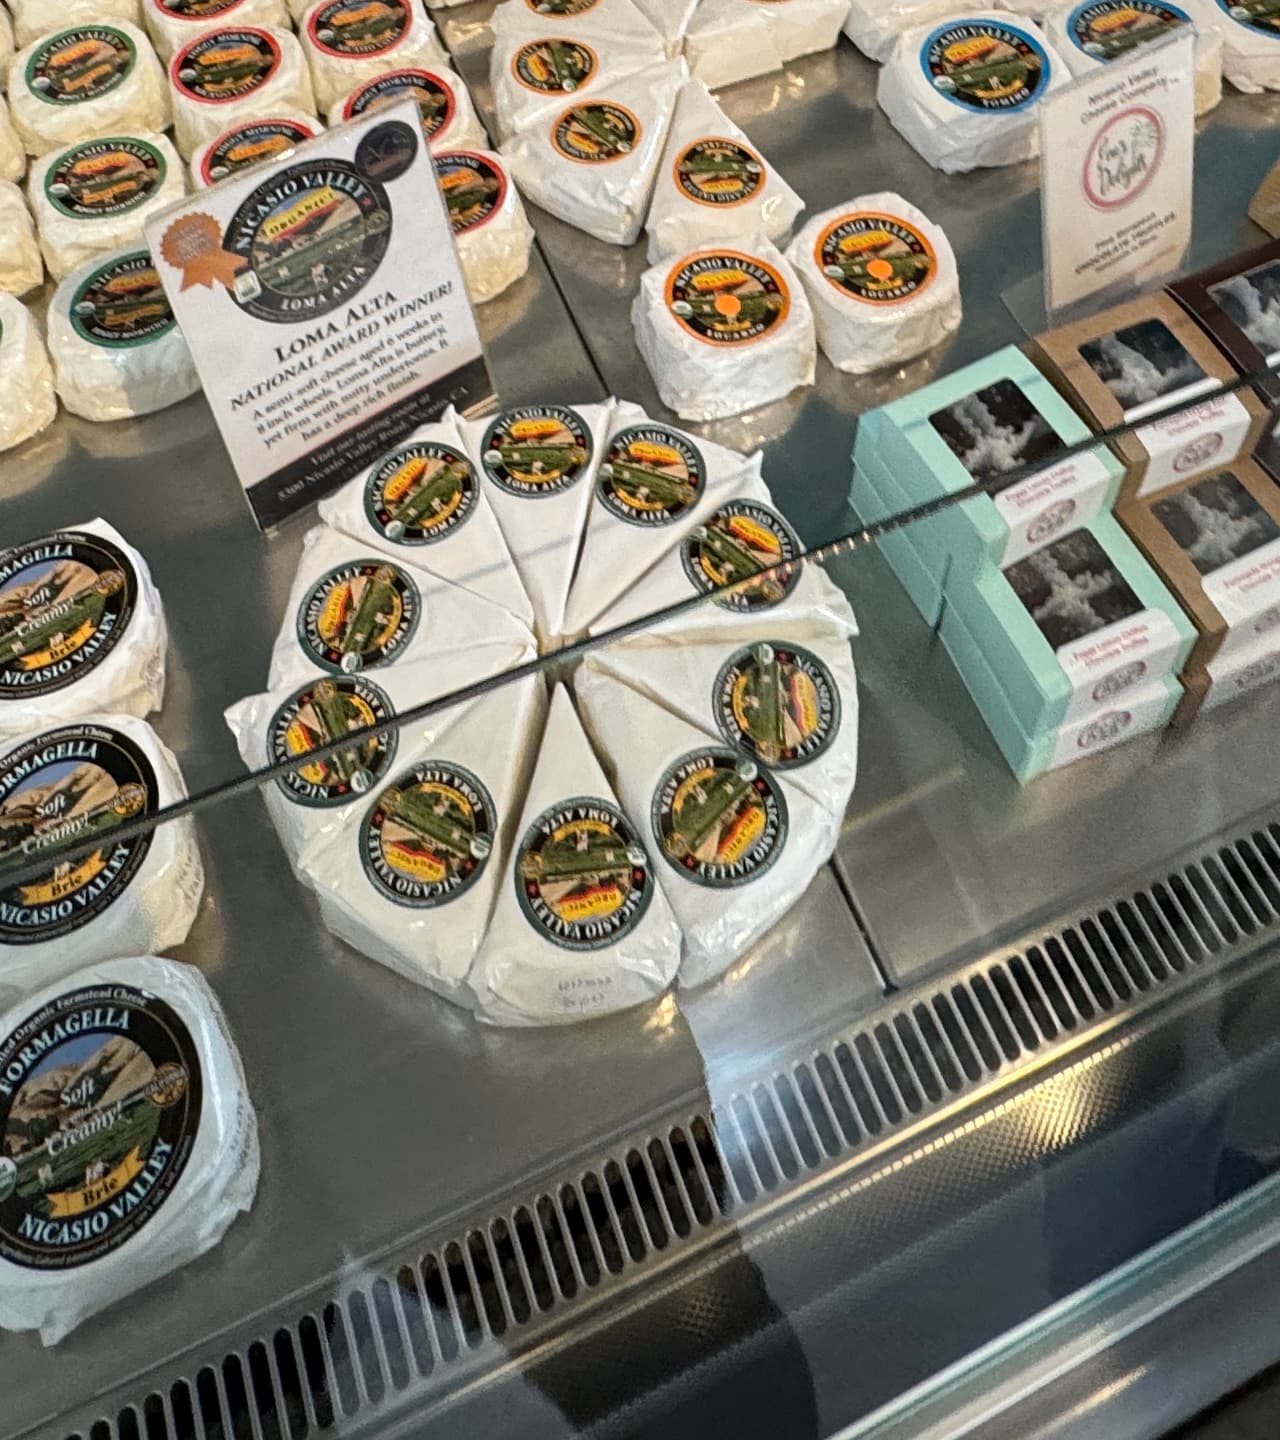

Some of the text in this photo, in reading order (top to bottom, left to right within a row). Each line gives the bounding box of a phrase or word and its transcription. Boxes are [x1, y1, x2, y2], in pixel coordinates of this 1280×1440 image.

[236, 178, 300, 252] NICASIO
[303, 169, 369, 199] VALLEY
[230, 280, 453, 411] NATIONAL AWARD WINNER!
[273, 291, 397, 362] LOMA ALTA
[0, 611, 118, 686] NICASIO VALLEY
[18, 1137, 172, 1245] NICASIO VALLEY
